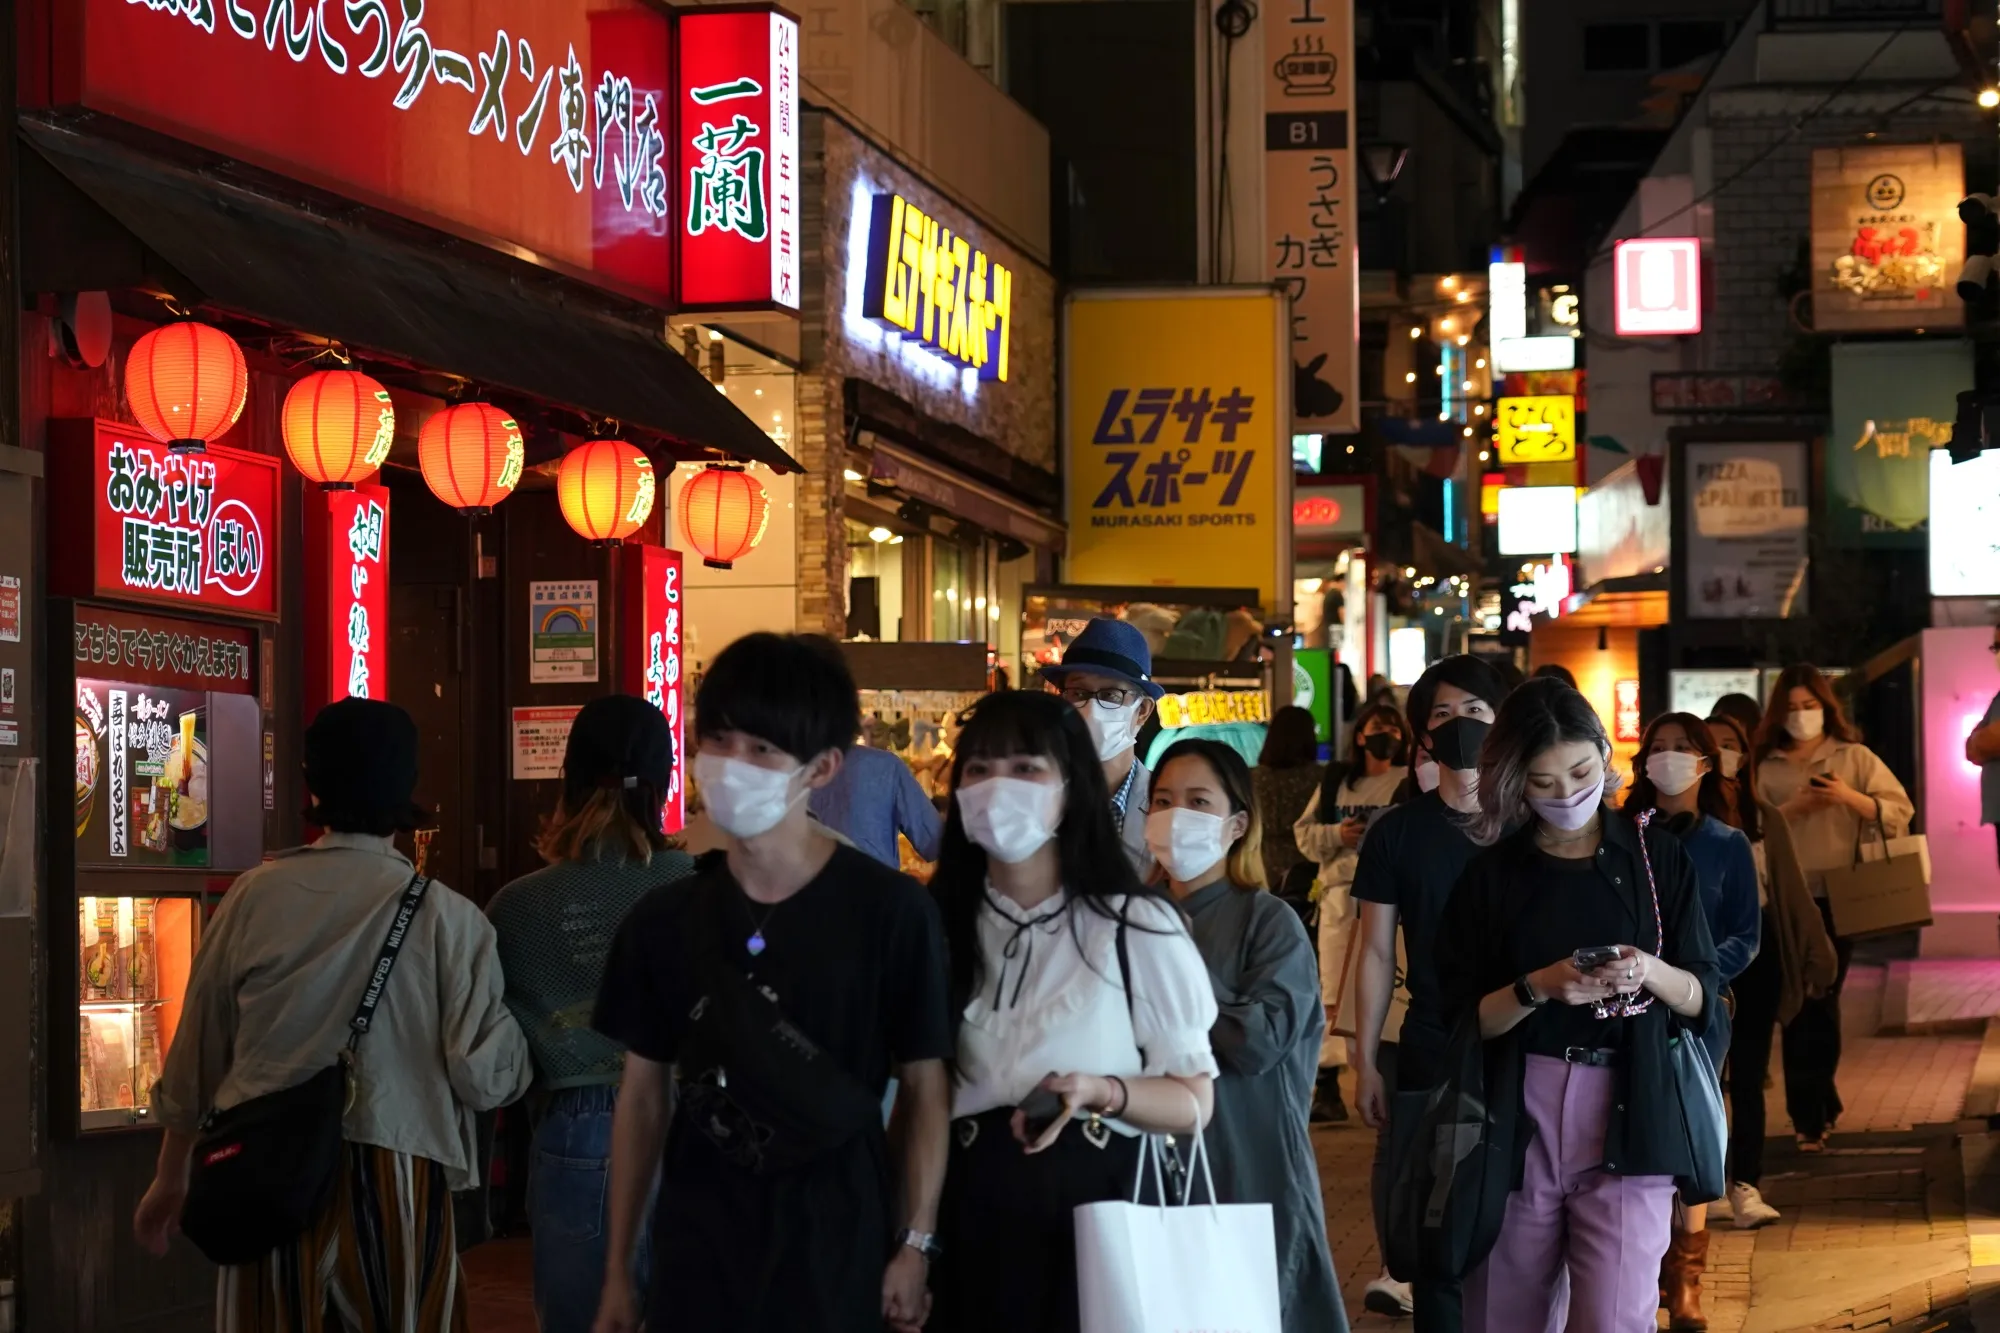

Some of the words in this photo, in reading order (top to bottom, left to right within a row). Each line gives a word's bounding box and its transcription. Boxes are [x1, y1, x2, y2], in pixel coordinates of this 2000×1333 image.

[687, 76, 768, 243] 一蘭
[1290, 121, 1318, 143] B1
[1308, 156, 1342, 268] うさぎ
[1092, 386, 1255, 445] ムラサキ
[107, 442, 216, 529] おみやげ
[1092, 449, 1255, 508] スポーツ
[1697, 462, 1749, 480] PIZZA
[1091, 515, 1182, 528] MURASAKI
[1187, 512, 1256, 527] SPORTS
[122, 516, 203, 595] 販売所
[213, 518, 258, 578] ばい
[362, 955, 394, 1008] MILKFED.
